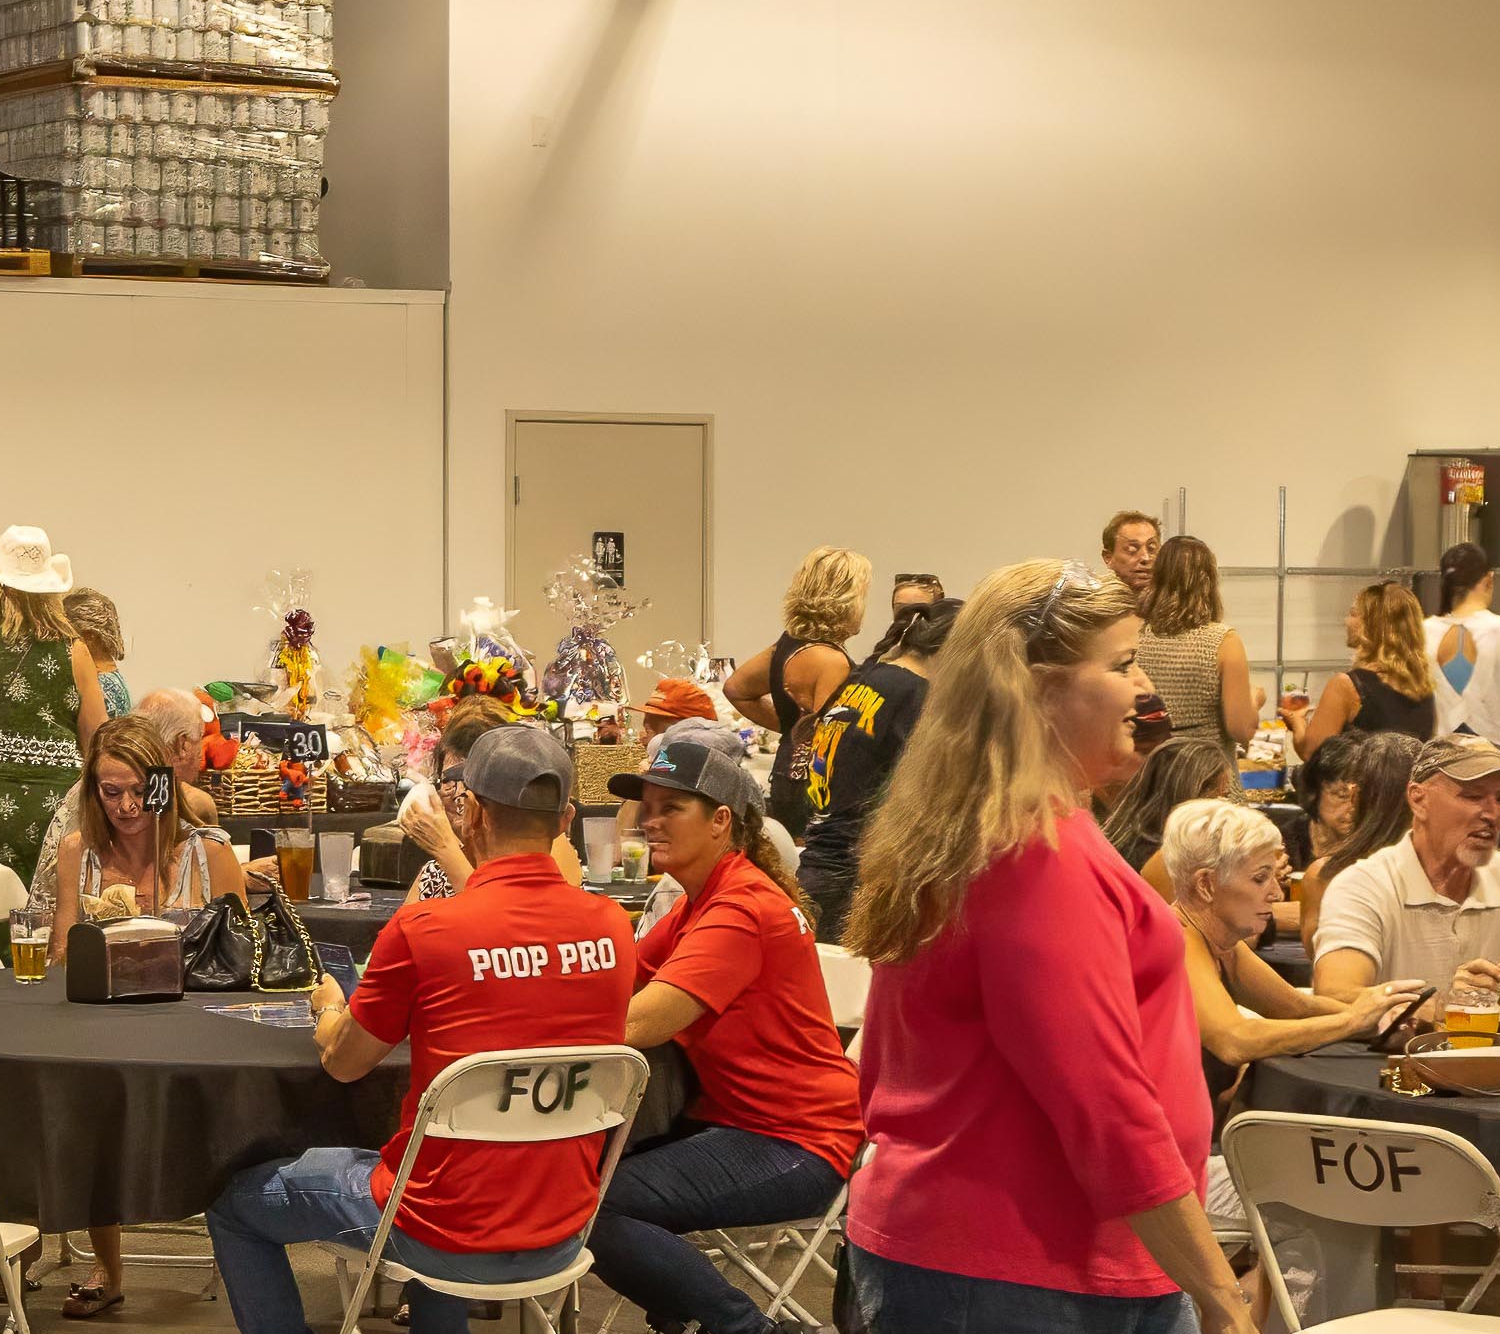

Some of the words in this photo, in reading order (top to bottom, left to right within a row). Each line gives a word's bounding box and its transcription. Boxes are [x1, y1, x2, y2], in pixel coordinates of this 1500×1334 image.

[293, 730, 323, 758] 30
[147, 773, 169, 806] 28
[467, 944, 549, 981] POOP
[556, 937, 617, 975] PRO
[497, 1062, 592, 1114] FOF
[1310, 1136, 1422, 1193] FOF
